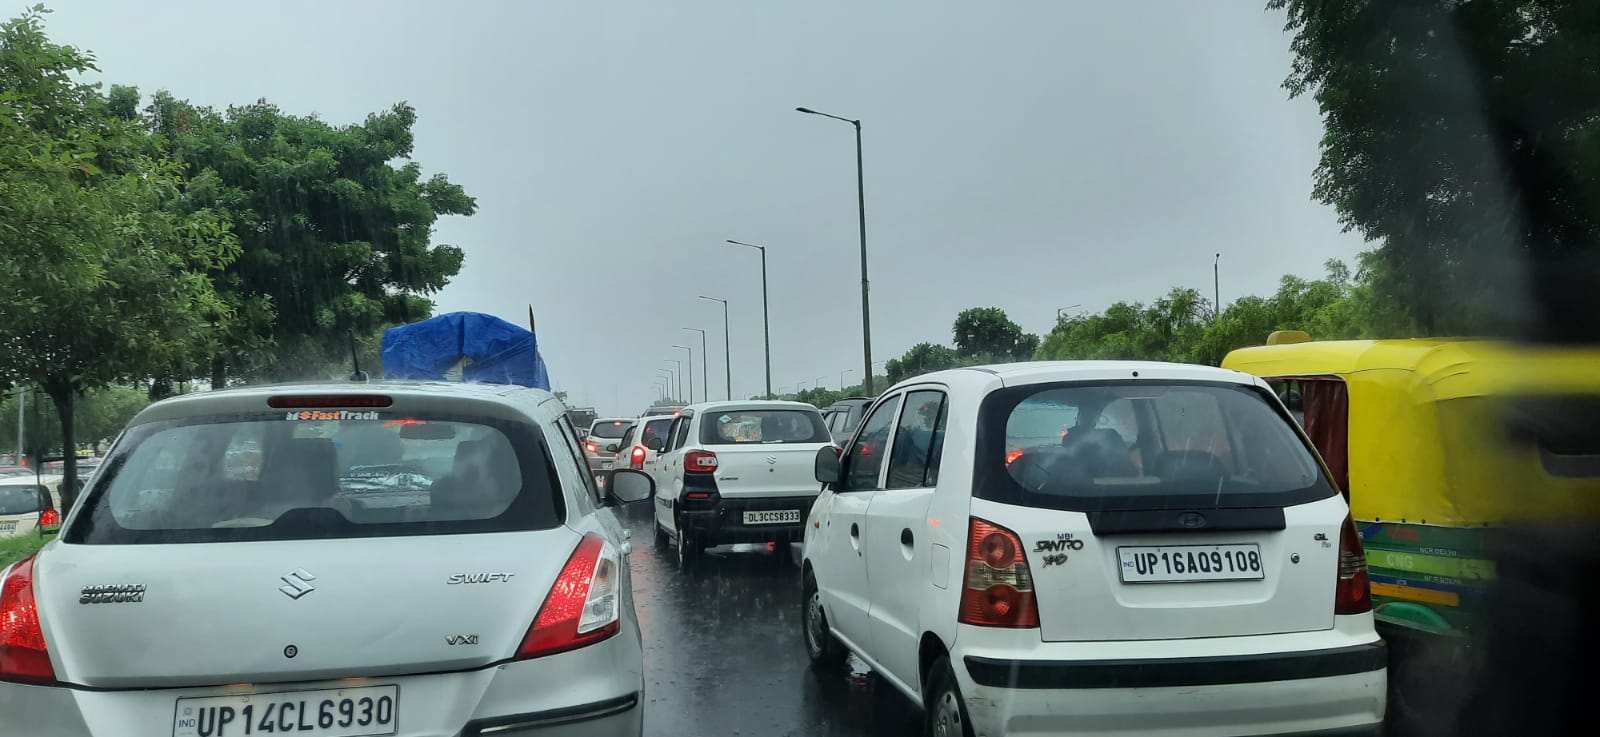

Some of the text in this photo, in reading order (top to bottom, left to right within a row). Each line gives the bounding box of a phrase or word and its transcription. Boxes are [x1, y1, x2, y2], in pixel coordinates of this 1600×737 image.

[1134, 551, 1260, 575] UP16AQ9108
[1386, 553, 1414, 569] CNG
[446, 572, 515, 584] SWIFT
[79, 592, 144, 604] SUZUKI
[178, 695, 393, 737] IND UP14CL6930
